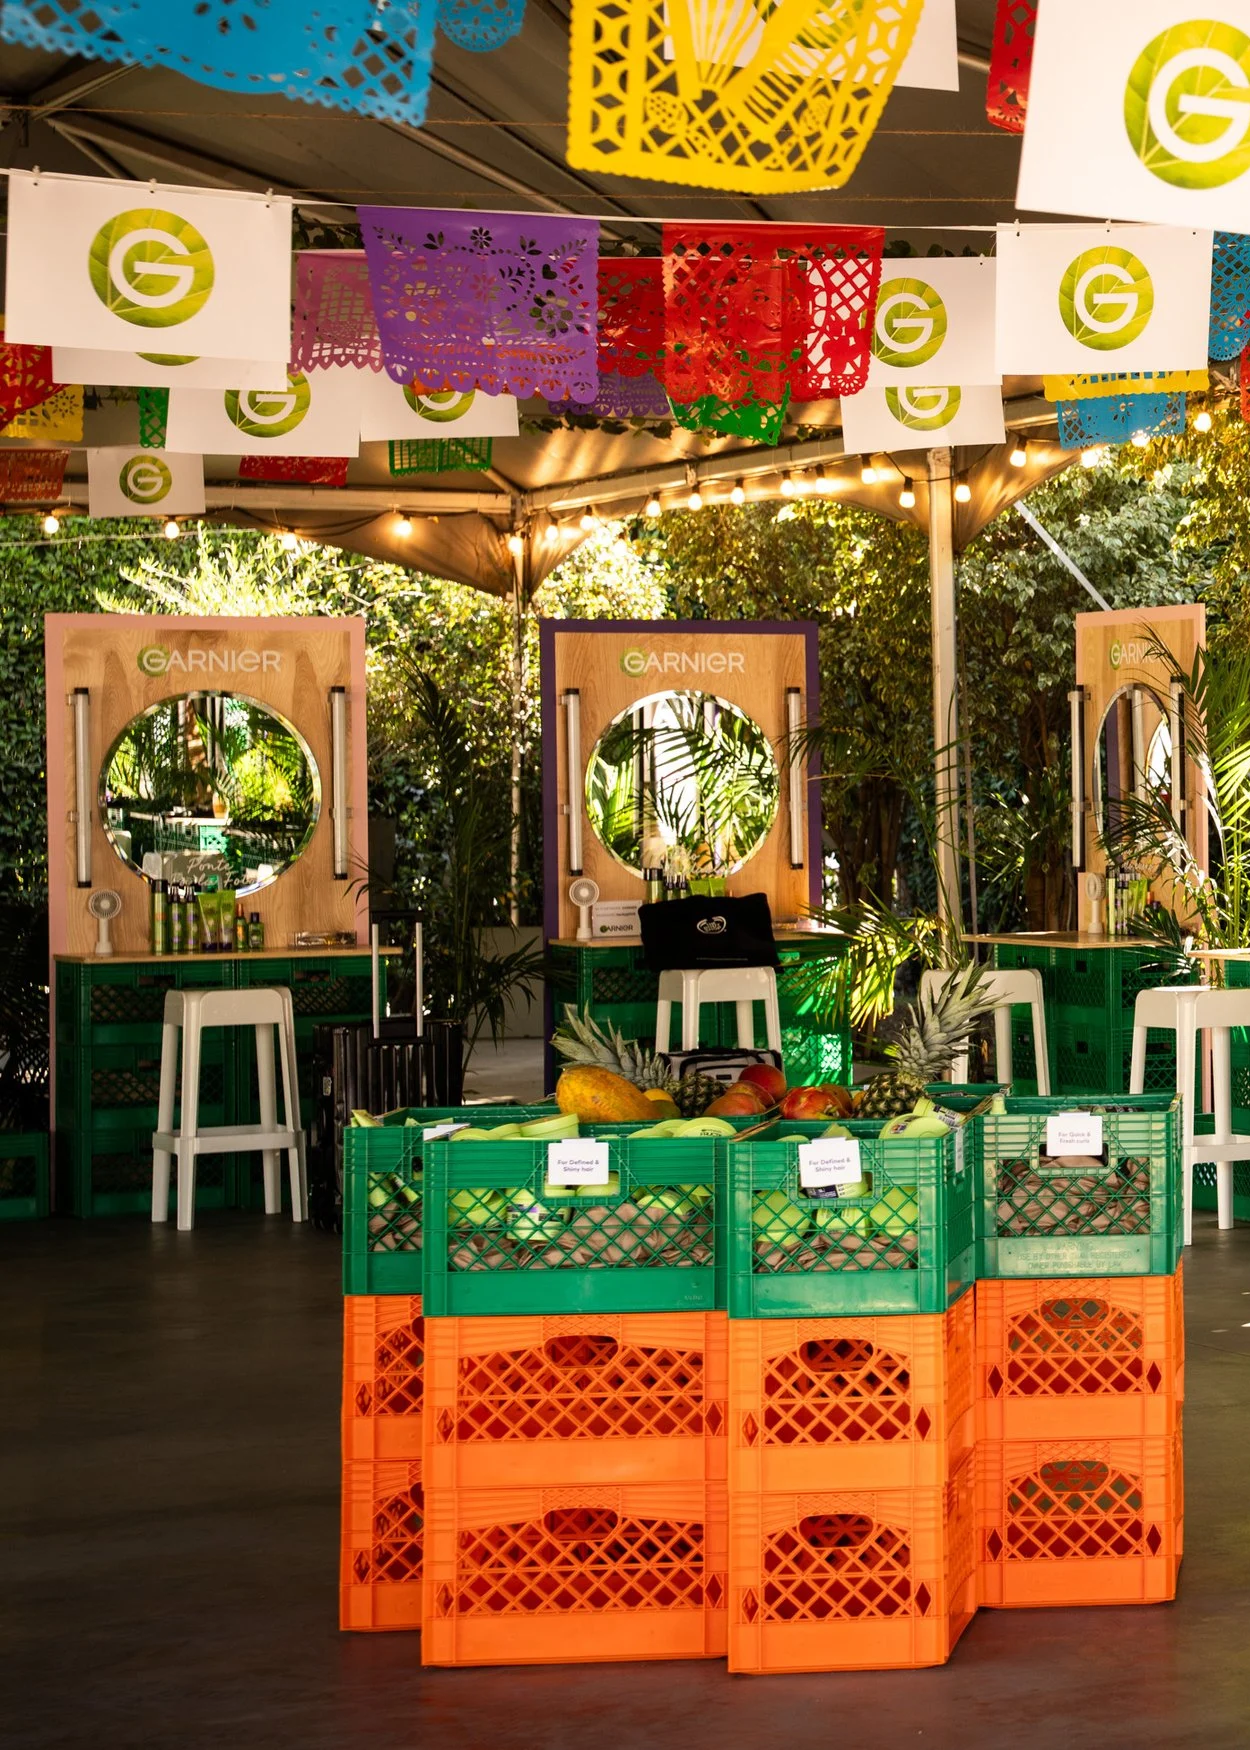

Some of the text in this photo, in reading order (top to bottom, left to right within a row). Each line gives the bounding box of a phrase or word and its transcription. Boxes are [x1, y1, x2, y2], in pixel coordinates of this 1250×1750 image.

[108, 228, 195, 308] G
[1074, 263, 1138, 334] G
[875, 292, 934, 353] G
[127, 463, 163, 497] G
[142, 649, 281, 672] GARNIER
[623, 651, 745, 673] GARNIER
[1110, 642, 1165, 665] GARNI
[187, 857, 234, 874] Ponte
